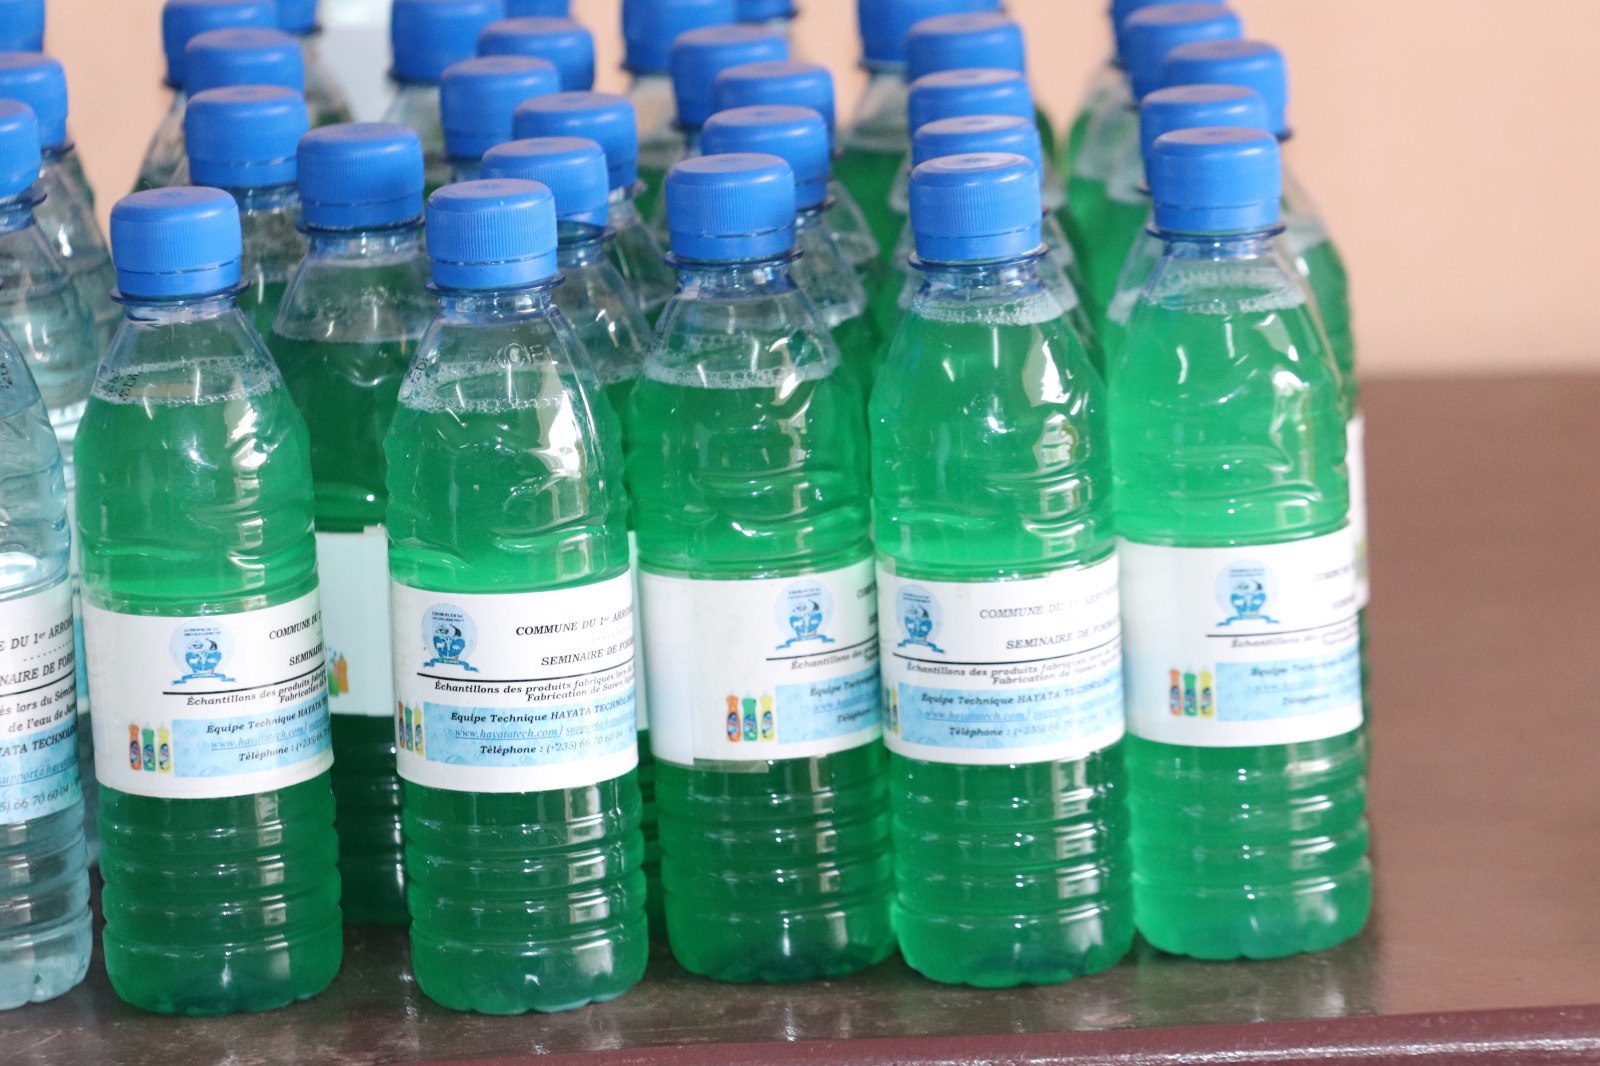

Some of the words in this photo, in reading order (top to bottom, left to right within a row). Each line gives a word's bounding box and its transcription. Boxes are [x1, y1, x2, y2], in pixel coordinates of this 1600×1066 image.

[980, 605, 1044, 619] COMMUNE
[269, 618, 311, 640] COMMUNE
[516, 622, 578, 636] COMMUNE
[582, 618, 596, 629] DU
[599, 616, 610, 626] 1er
[11, 635, 29, 650] DU
[33, 632, 46, 644] 1er
[1006, 632, 1073, 650] SEMINAIRE
[541, 649, 603, 666] SEMINAIRE
[606, 645, 617, 656] DE
[791, 655, 850, 670] Échantillons
[43, 661, 55, 677] DE
[907, 662, 965, 677] Échantillons
[969, 667, 987, 676] des
[991, 663, 1038, 677] produits
[434, 680, 499, 694] Échantillons
[503, 685, 522, 694] des
[525, 681, 571, 695] produits
[572, 672, 614, 693] fabriqués
[992, 672, 1055, 685] Fabrication
[187, 692, 256, 706] Échantillons
[260, 690, 276, 698] des
[278, 679, 310, 698] produits
[279, 682, 319, 704] Fabrication
[527, 688, 587, 702] Fabrication
[590, 685, 601, 694] de
[603, 681, 623, 692] Savon
[810, 685, 841, 697] Equipe
[921, 693, 954, 704] Equipe
[958, 696, 1014, 706] Technique
[1017, 690, 1061, 703] HAYATA
[16, 700, 37, 713] lors
[40, 693, 52, 707] du
[8, 721, 23, 733] de
[27, 714, 52, 729] l'eau
[54, 709, 63, 720] de
[206, 721, 244, 735] Equipe
[248, 712, 295, 730] Technique
[297, 702, 322, 718] HAYATA
[451, 712, 487, 724] Equipe
[490, 713, 548, 724] Technique
[551, 708, 591, 720] HAYATA
[455, 728, 561, 741] www.hayatatech.com
[949, 726, 1003, 737] Téléphone
[239, 746, 288, 762] Téléphone
[480, 745, 537, 757] Téléphone
[546, 740, 577, 754] (+235)
[580, 738, 591, 748] 66
[14, 799, 28, 810] 66
[33, 793, 45, 806] 70
[47, 787, 58, 800] 60
